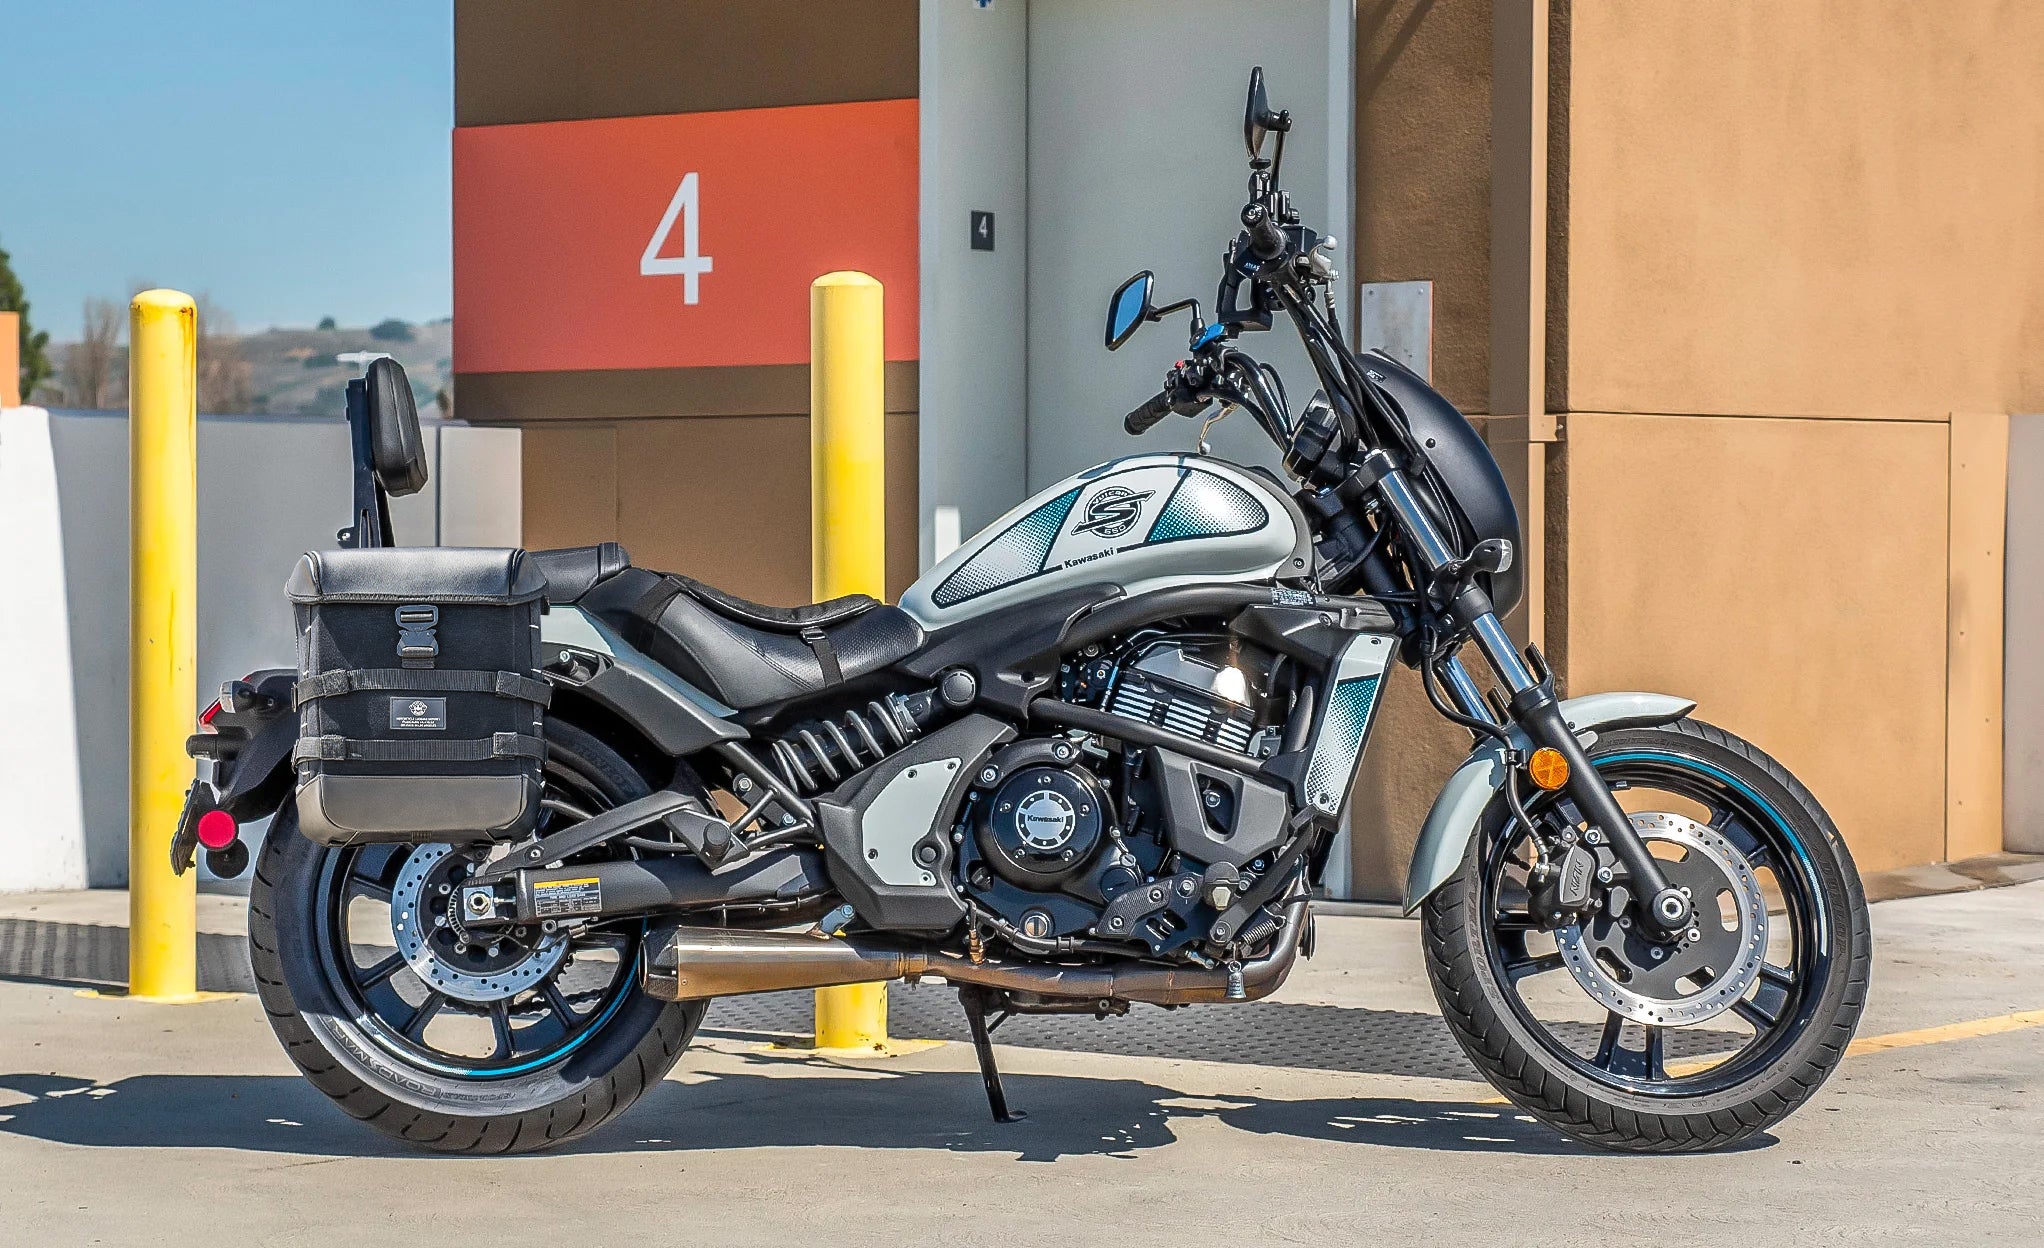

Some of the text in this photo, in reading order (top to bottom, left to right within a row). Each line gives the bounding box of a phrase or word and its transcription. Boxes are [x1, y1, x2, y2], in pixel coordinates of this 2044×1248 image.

[979, 215, 988, 238] 4
[640, 171, 714, 306] 4
[1092, 490, 1129, 505] VULCAN
[1064, 547, 1114, 569] Kawasaki
[1027, 814, 1064, 823] Kawasaki
